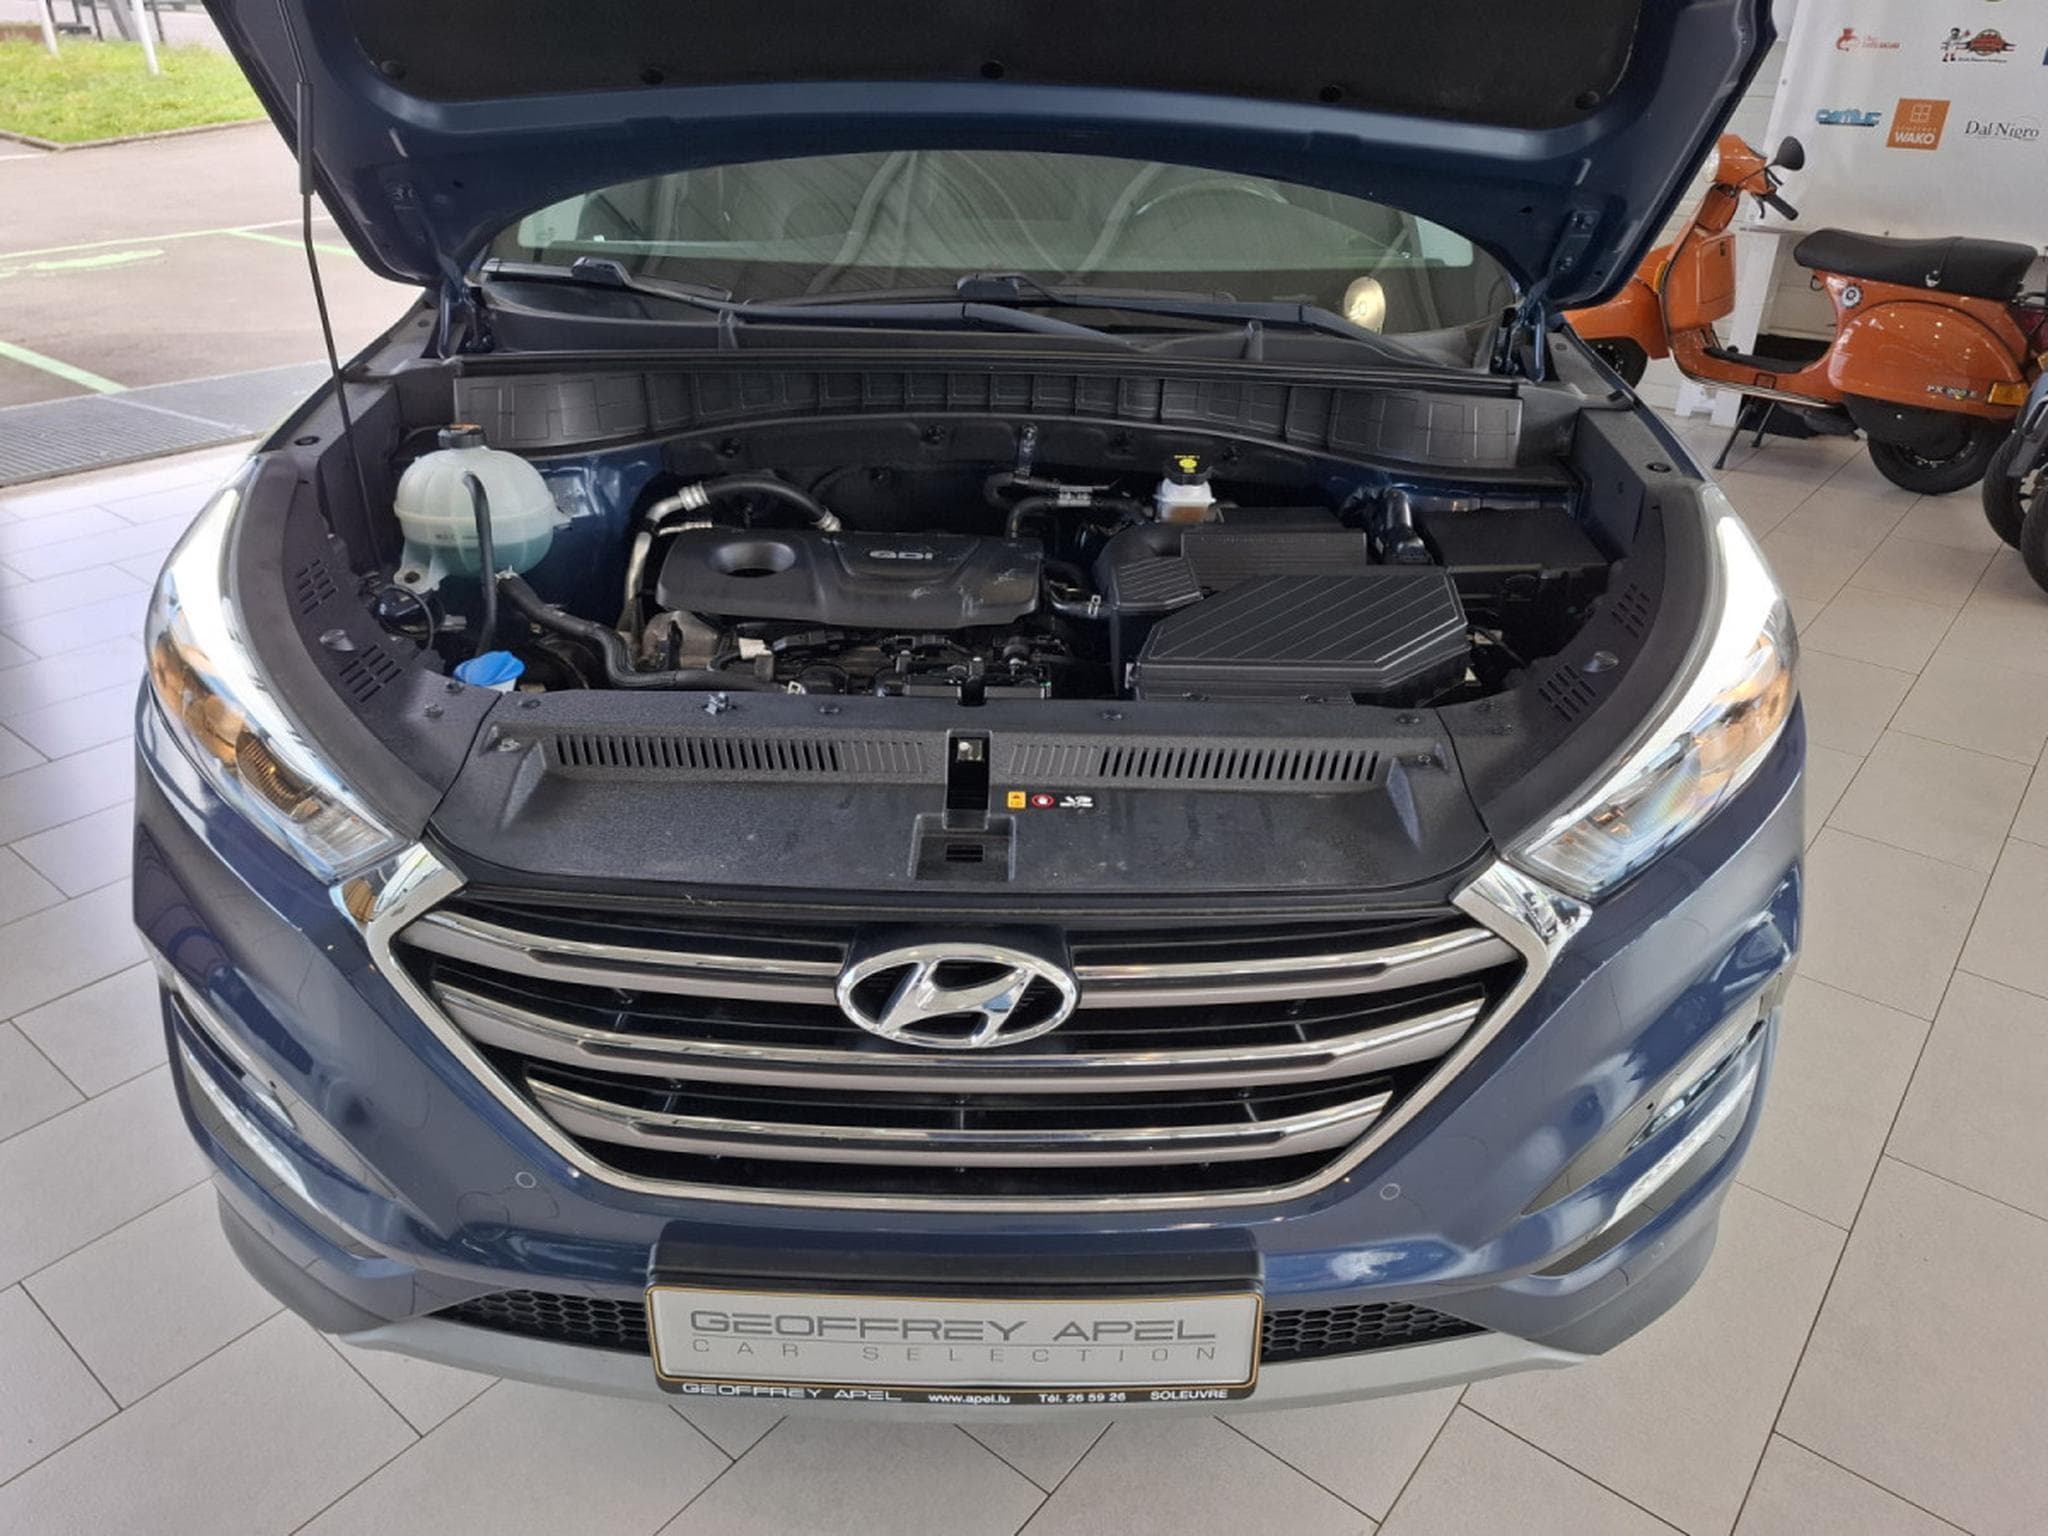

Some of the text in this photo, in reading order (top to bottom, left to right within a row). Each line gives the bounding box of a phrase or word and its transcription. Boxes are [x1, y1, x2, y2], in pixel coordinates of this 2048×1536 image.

[1894, 131, 1935, 145] WAKO
[1965, 120, 2039, 140] Dal Nigro
[691, 1310, 1216, 1342] GEOFFREY APEL
[692, 1338, 1215, 1364] CAR SELECTION
[682, 1383, 821, 1398] GEOFFREY
[834, 1389, 902, 1401] APEL
[928, 1393, 1010, 1405] www.apel.lu
[1150, 1389, 1228, 1401] SOLEUVRE
